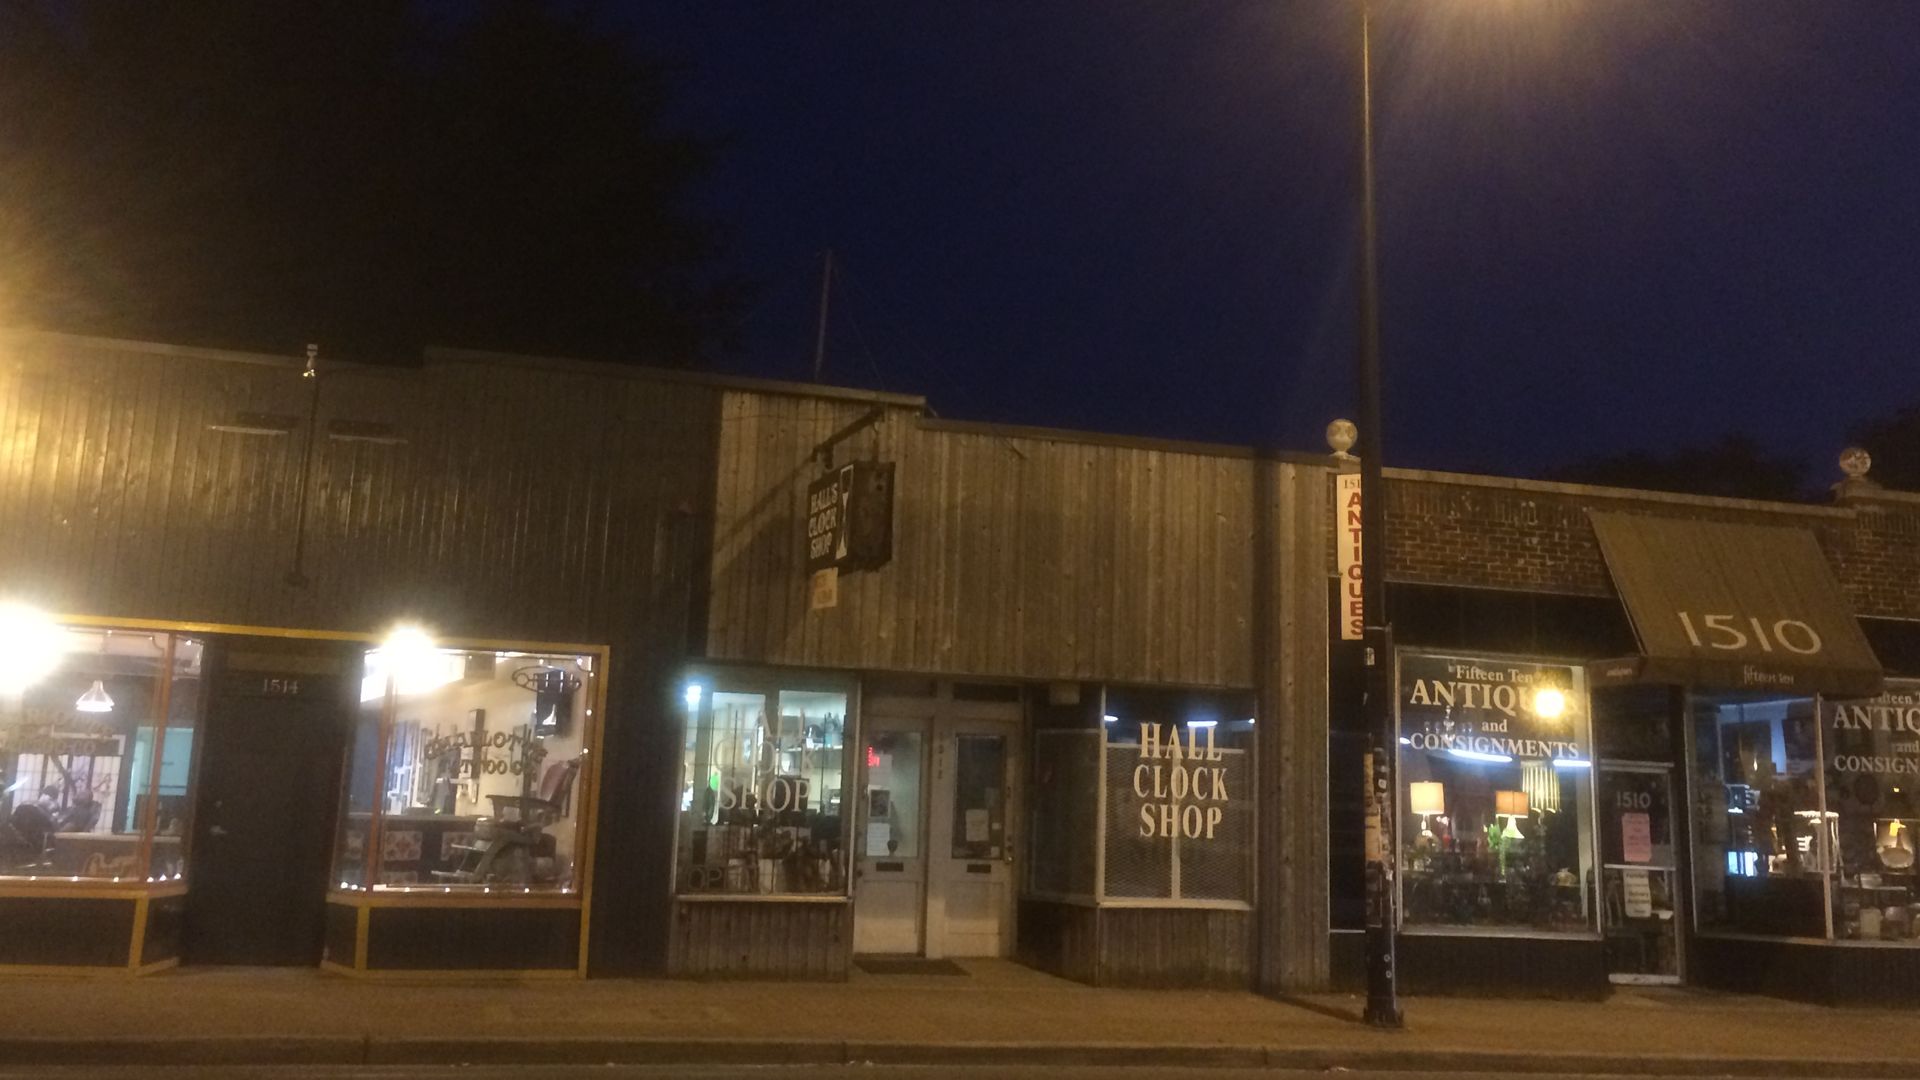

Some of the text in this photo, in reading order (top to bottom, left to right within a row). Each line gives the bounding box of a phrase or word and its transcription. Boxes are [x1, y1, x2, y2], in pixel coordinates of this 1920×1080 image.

[808, 506, 837, 538] CLOCK
[810, 531, 832, 560] SHOP
[1347, 492, 1363, 636] ANTIQUES
[1678, 611, 1822, 655] 1510
[263, 678, 299, 695] 1514
[1456, 665, 1534, 684] Fifteen Ten
[1140, 722, 1222, 761] HALL
[1482, 719, 1508, 732] and
[1410, 732, 1580, 760] CONSIGNMENTS
[719, 775, 812, 812] SHOP
[1133, 764, 1229, 800] CLOCK
[1616, 792, 1652, 809] 1510
[1140, 803, 1222, 839] SHOP
